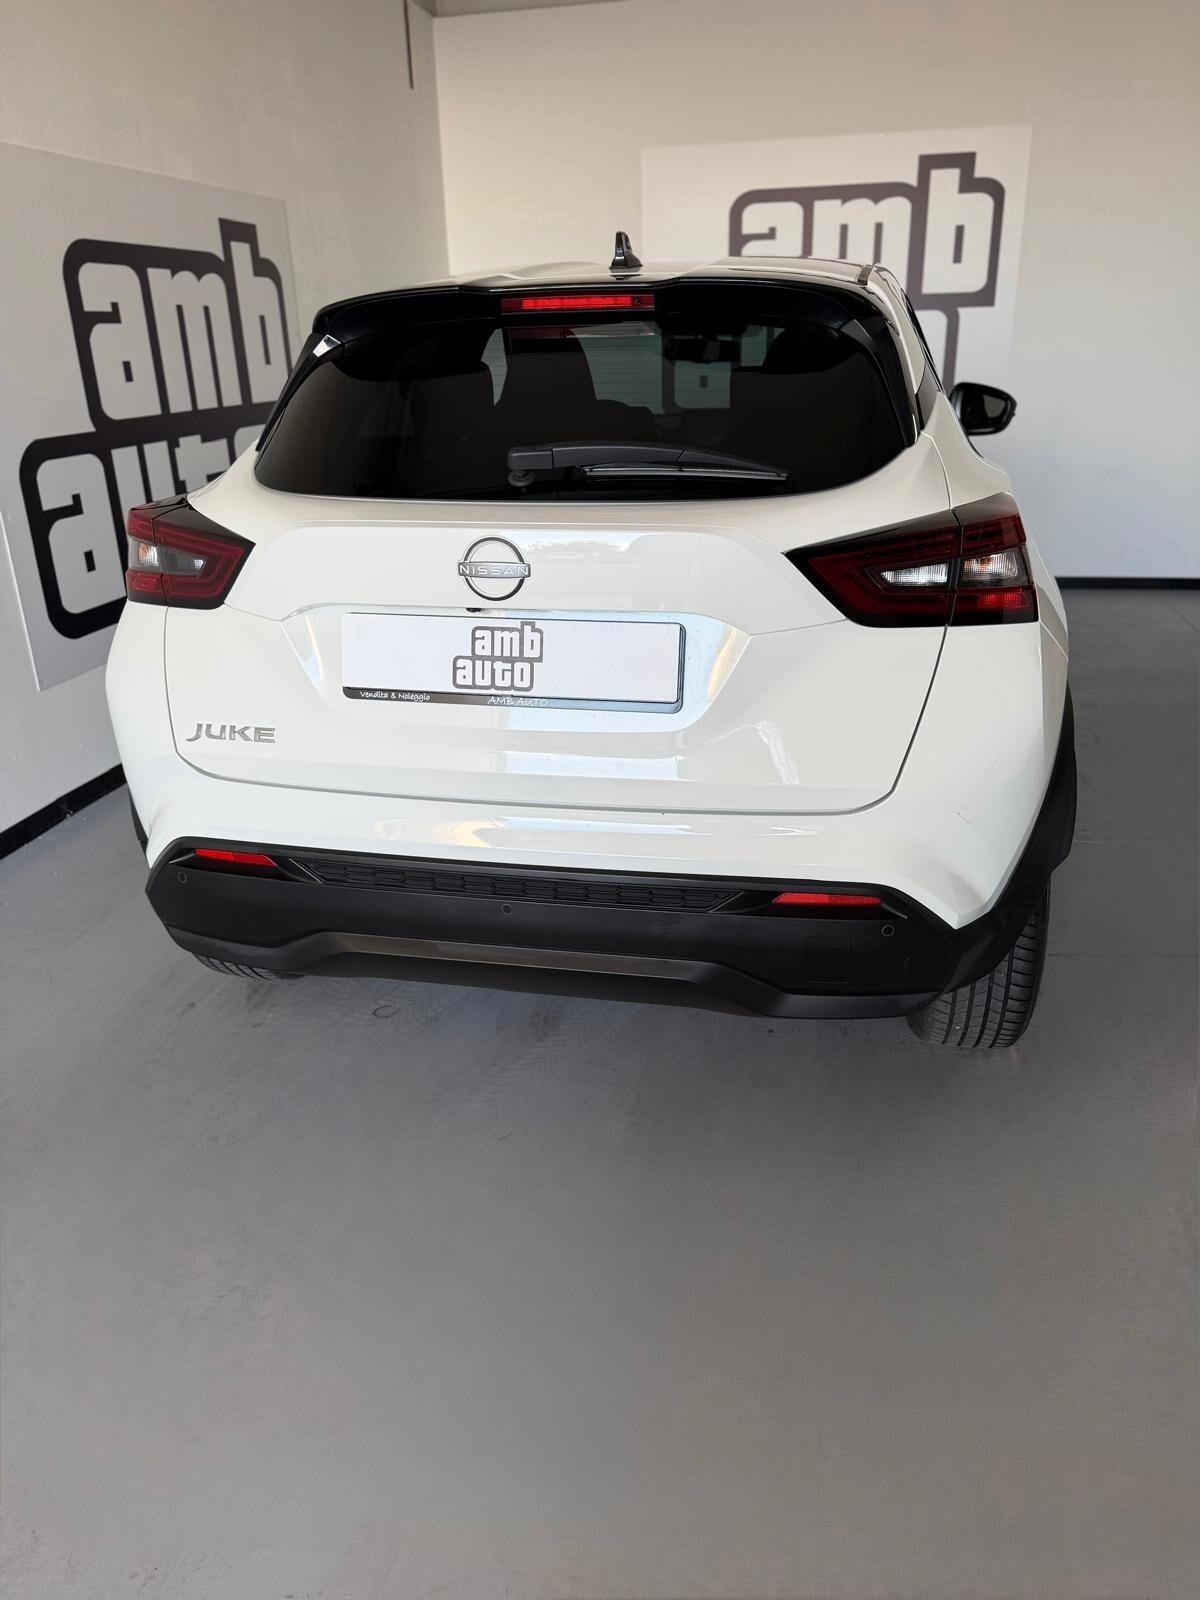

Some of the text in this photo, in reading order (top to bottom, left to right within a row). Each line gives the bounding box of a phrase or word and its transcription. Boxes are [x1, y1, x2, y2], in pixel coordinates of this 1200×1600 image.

[728, 153, 1005, 305] amb
[65, 219, 292, 426] amb
[459, 564, 529, 576] NISSAN
[473, 621, 542, 660] amb
[454, 657, 533, 690] auto
[360, 690, 388, 699] Vendita
[399, 693, 431, 702] Noleggio
[488, 696, 548, 706] AMB AUTO
[186, 723, 276, 743] JUKE
